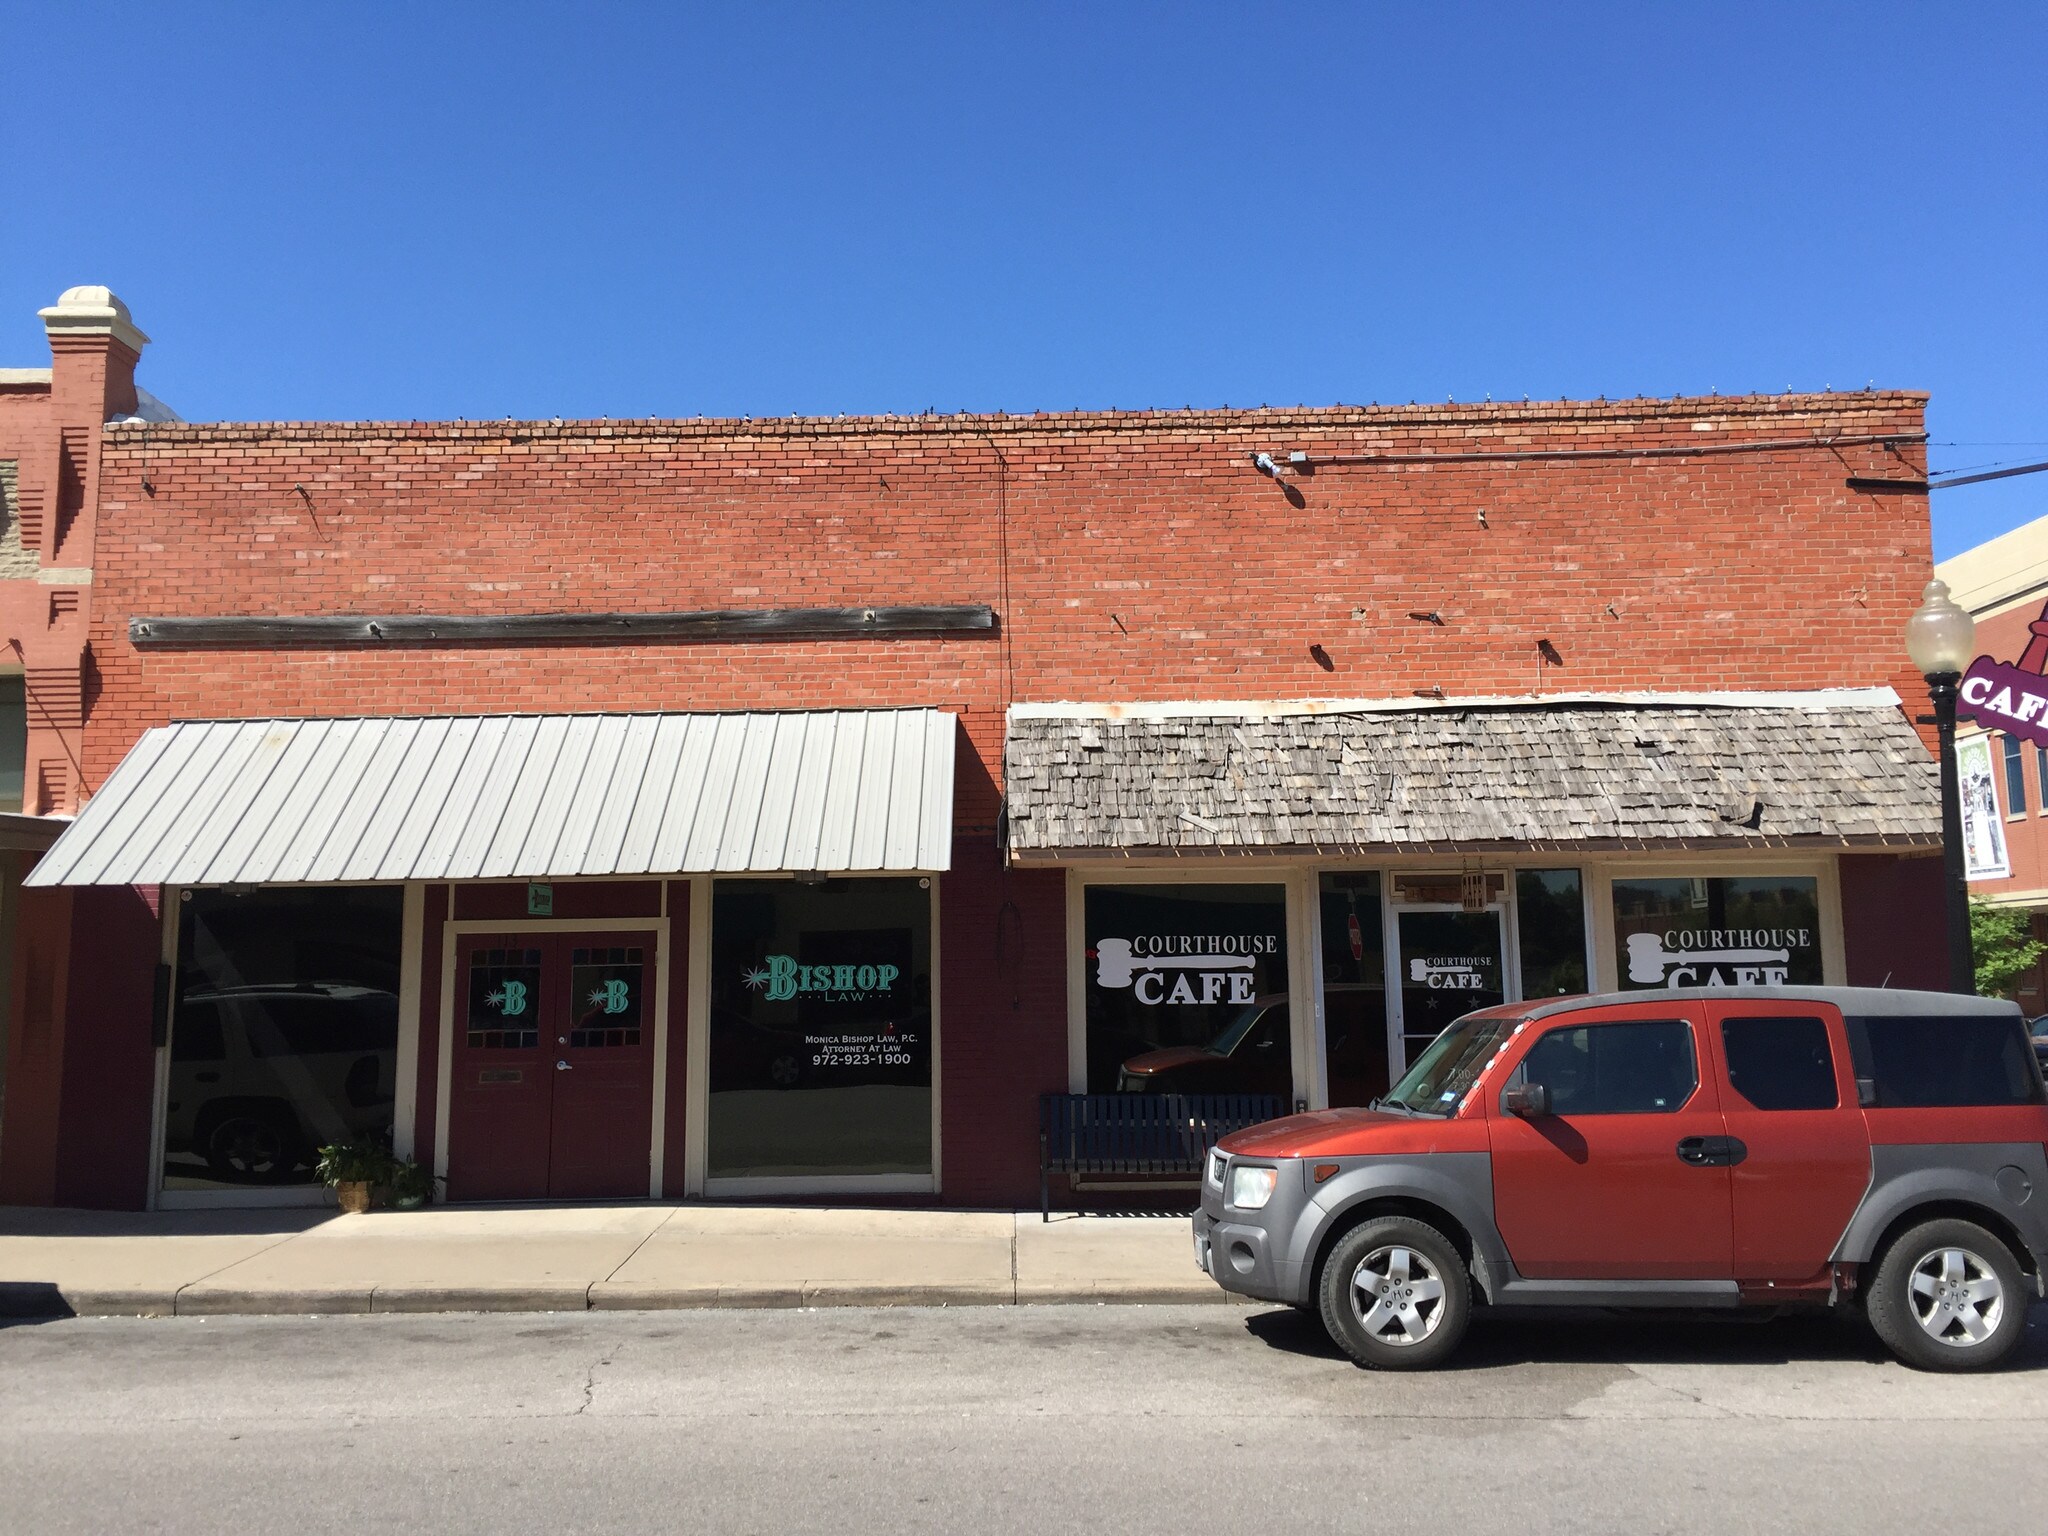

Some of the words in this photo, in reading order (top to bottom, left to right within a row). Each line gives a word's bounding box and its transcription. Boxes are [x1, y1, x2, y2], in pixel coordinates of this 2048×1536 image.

[1134, 935, 1277, 954] COURTHOUSE
[1664, 928, 1811, 949] COURTHOUSE
[1426, 956, 1492, 967] COURTHOUSE
[764, 954, 899, 1001] BISHOP
[1428, 973, 1483, 989] CAFE
[603, 979, 629, 1015] B
[824, 991, 866, 1002] LAW
[1134, 972, 1256, 1005] CAFE
[501, 980, 527, 1016] B
[805, 1035, 839, 1044] MONICA
[841, 1034, 874, 1044] BISHOP
[877, 1034, 898, 1044] LAW,
[901, 1034, 918, 1043] P.C.
[822, 1045, 866, 1053] ATTORNEY
[868, 1044, 881, 1052] AT
[883, 1044, 901, 1052] LAW
[812, 1053, 911, 1066] 972-923-1900
